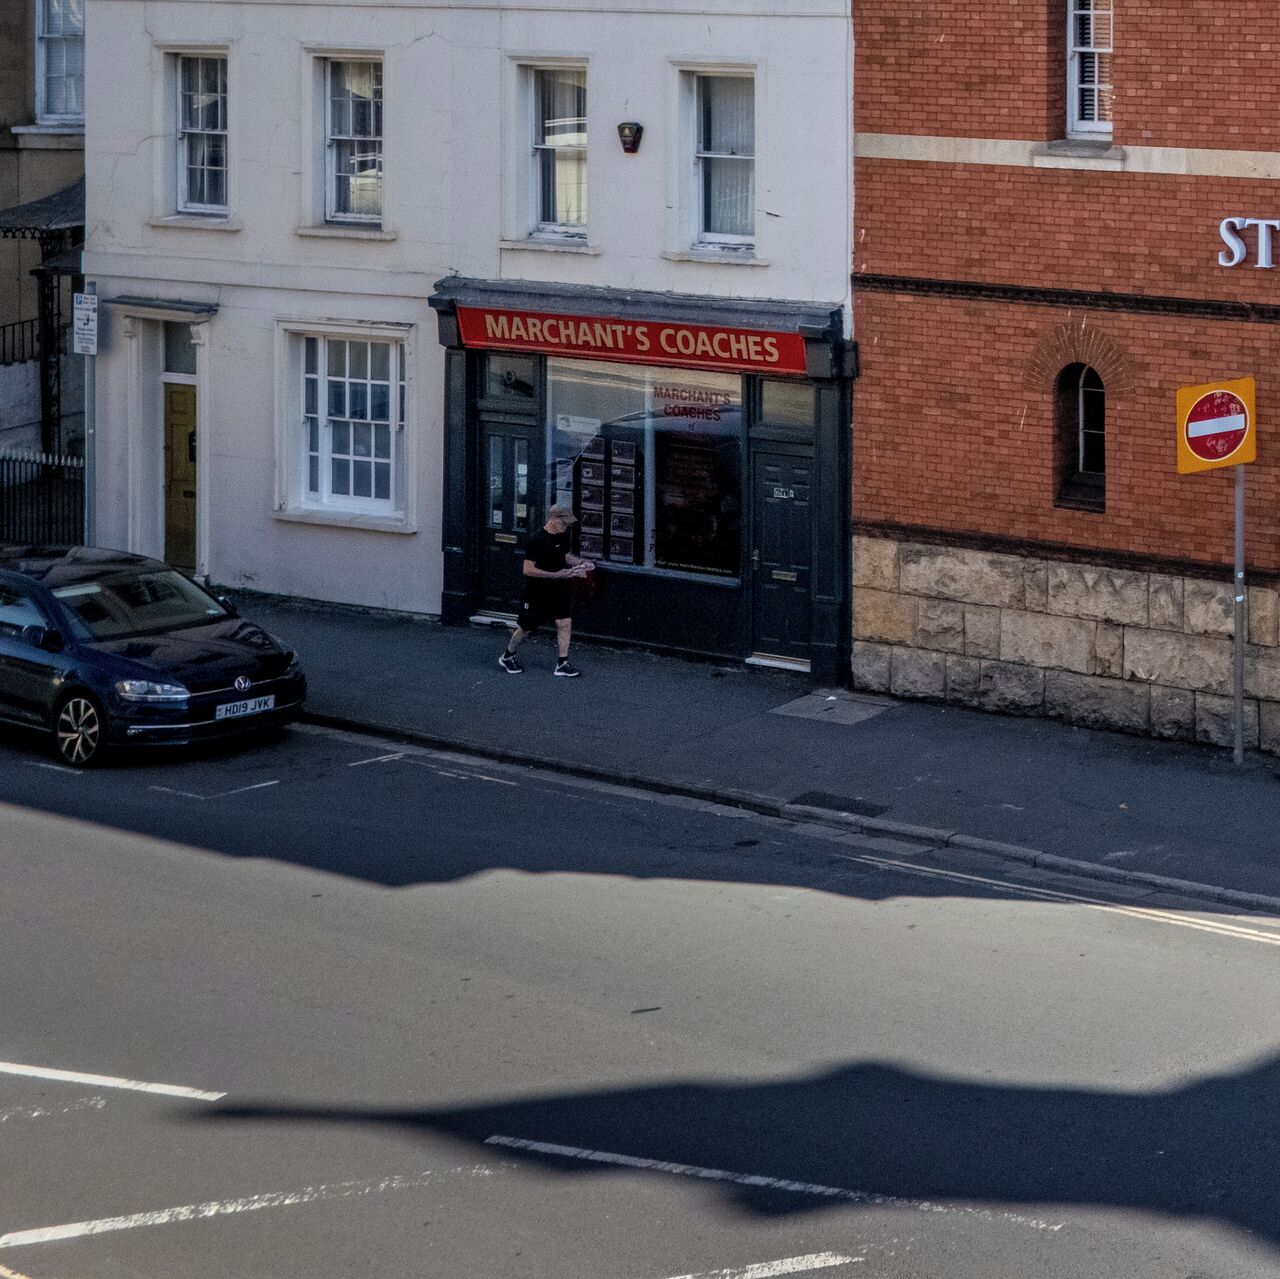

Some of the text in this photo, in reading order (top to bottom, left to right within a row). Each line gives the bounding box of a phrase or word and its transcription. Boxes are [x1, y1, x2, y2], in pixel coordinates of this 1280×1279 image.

[485, 314, 779, 363] MARCHANT'S COACHES
[654, 387, 731, 405] MARCHANT'S
[663, 405, 721, 421] COACHES
[225, 698, 270, 716] HD19 JVK
